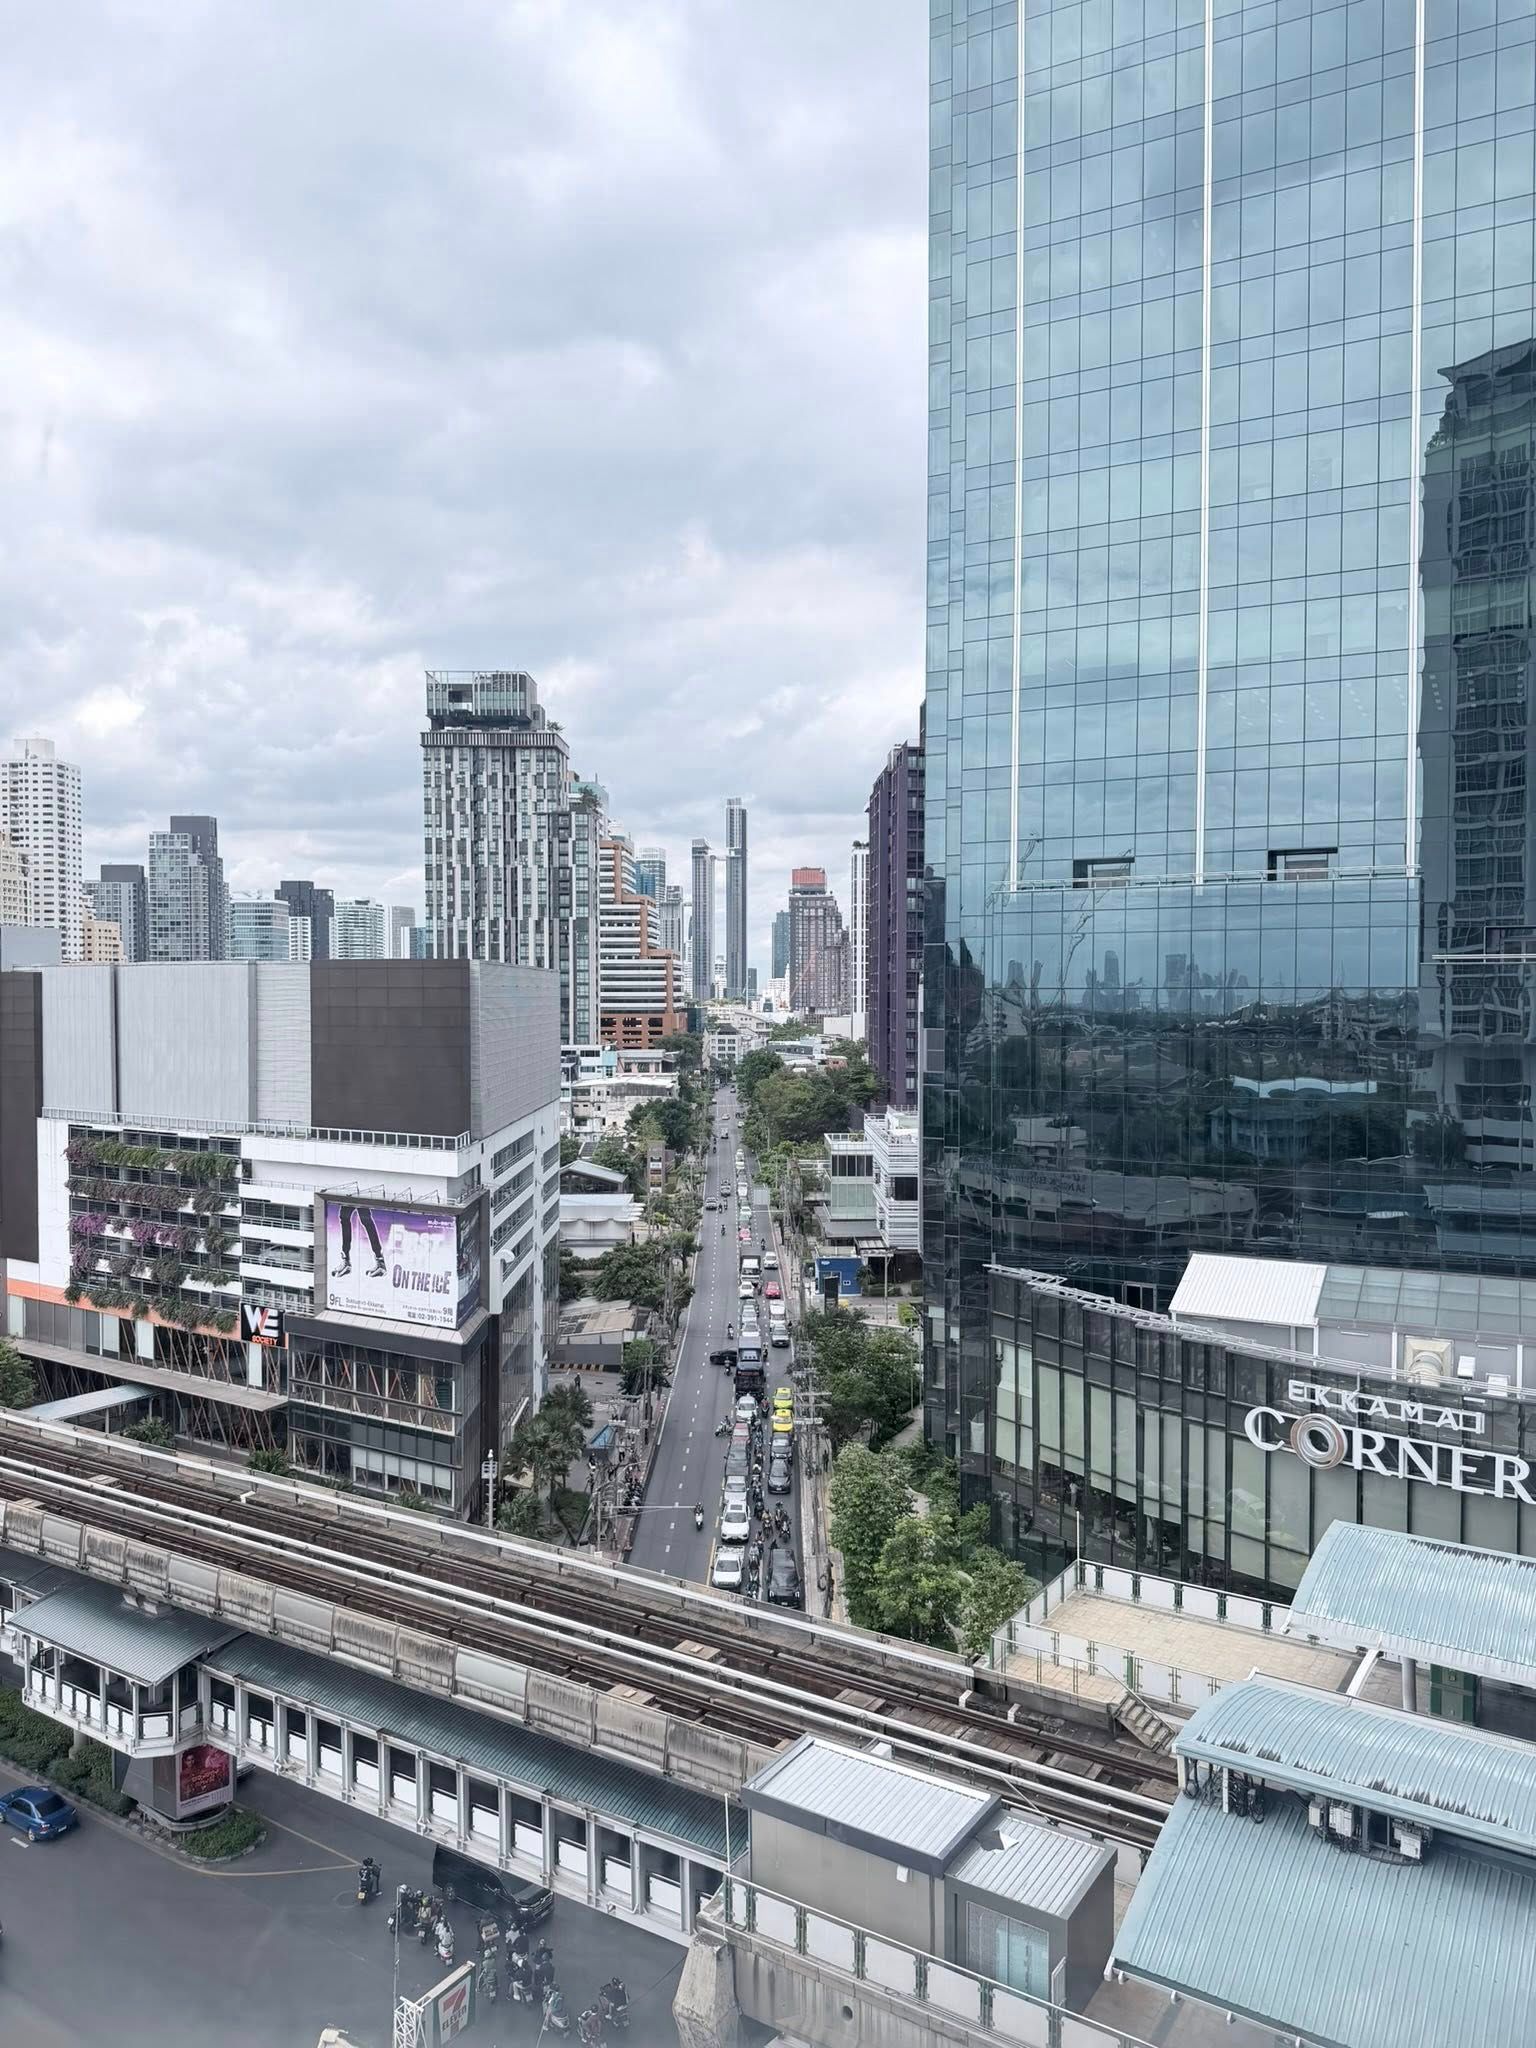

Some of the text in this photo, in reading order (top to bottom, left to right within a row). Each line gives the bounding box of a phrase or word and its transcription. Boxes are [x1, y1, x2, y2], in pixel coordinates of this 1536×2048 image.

[393, 1264, 452, 1295] ON THE ICE
[243, 1304, 279, 1338] WE
[1288, 1379, 1486, 1435] EKKAMAI
[1244, 1405, 1536, 1505] CORNER
[443, 1983, 467, 2014] 7
